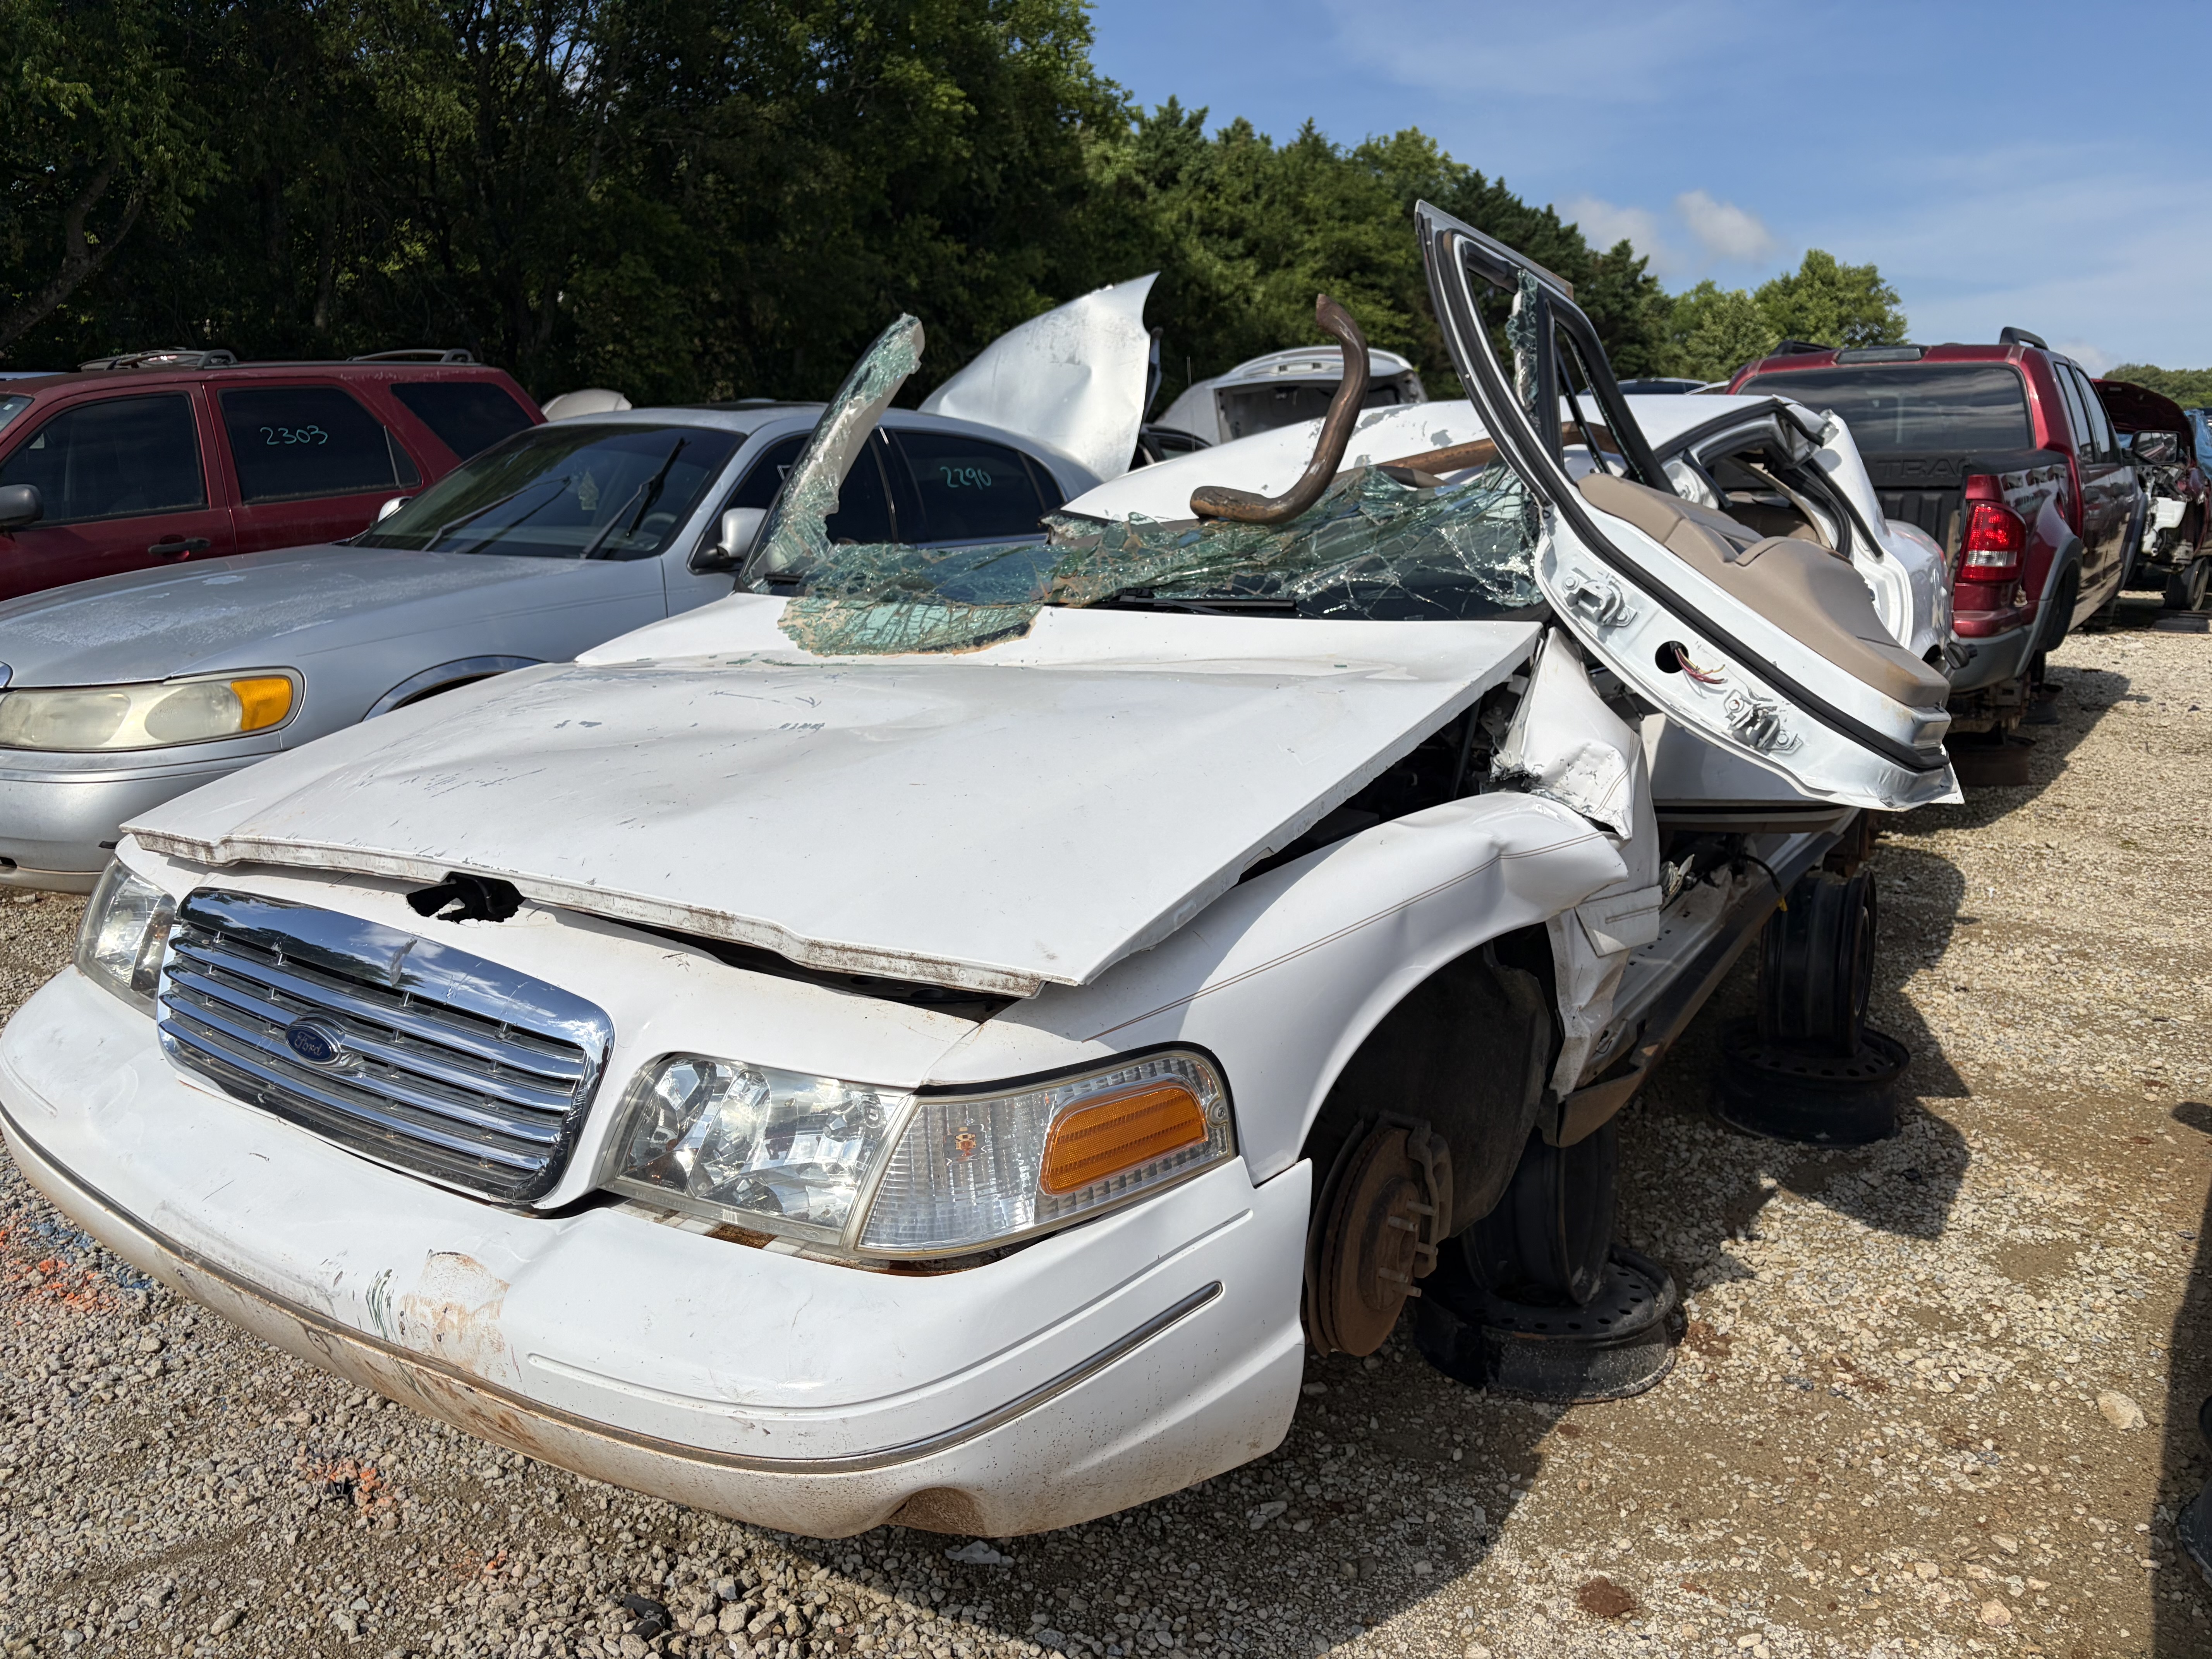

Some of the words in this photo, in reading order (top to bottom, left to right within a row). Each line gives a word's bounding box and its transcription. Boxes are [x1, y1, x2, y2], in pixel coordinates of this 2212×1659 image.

[260, 425, 328, 445] 2303
[939, 466, 992, 490] 2290
[294, 1031, 322, 1056] Ford
